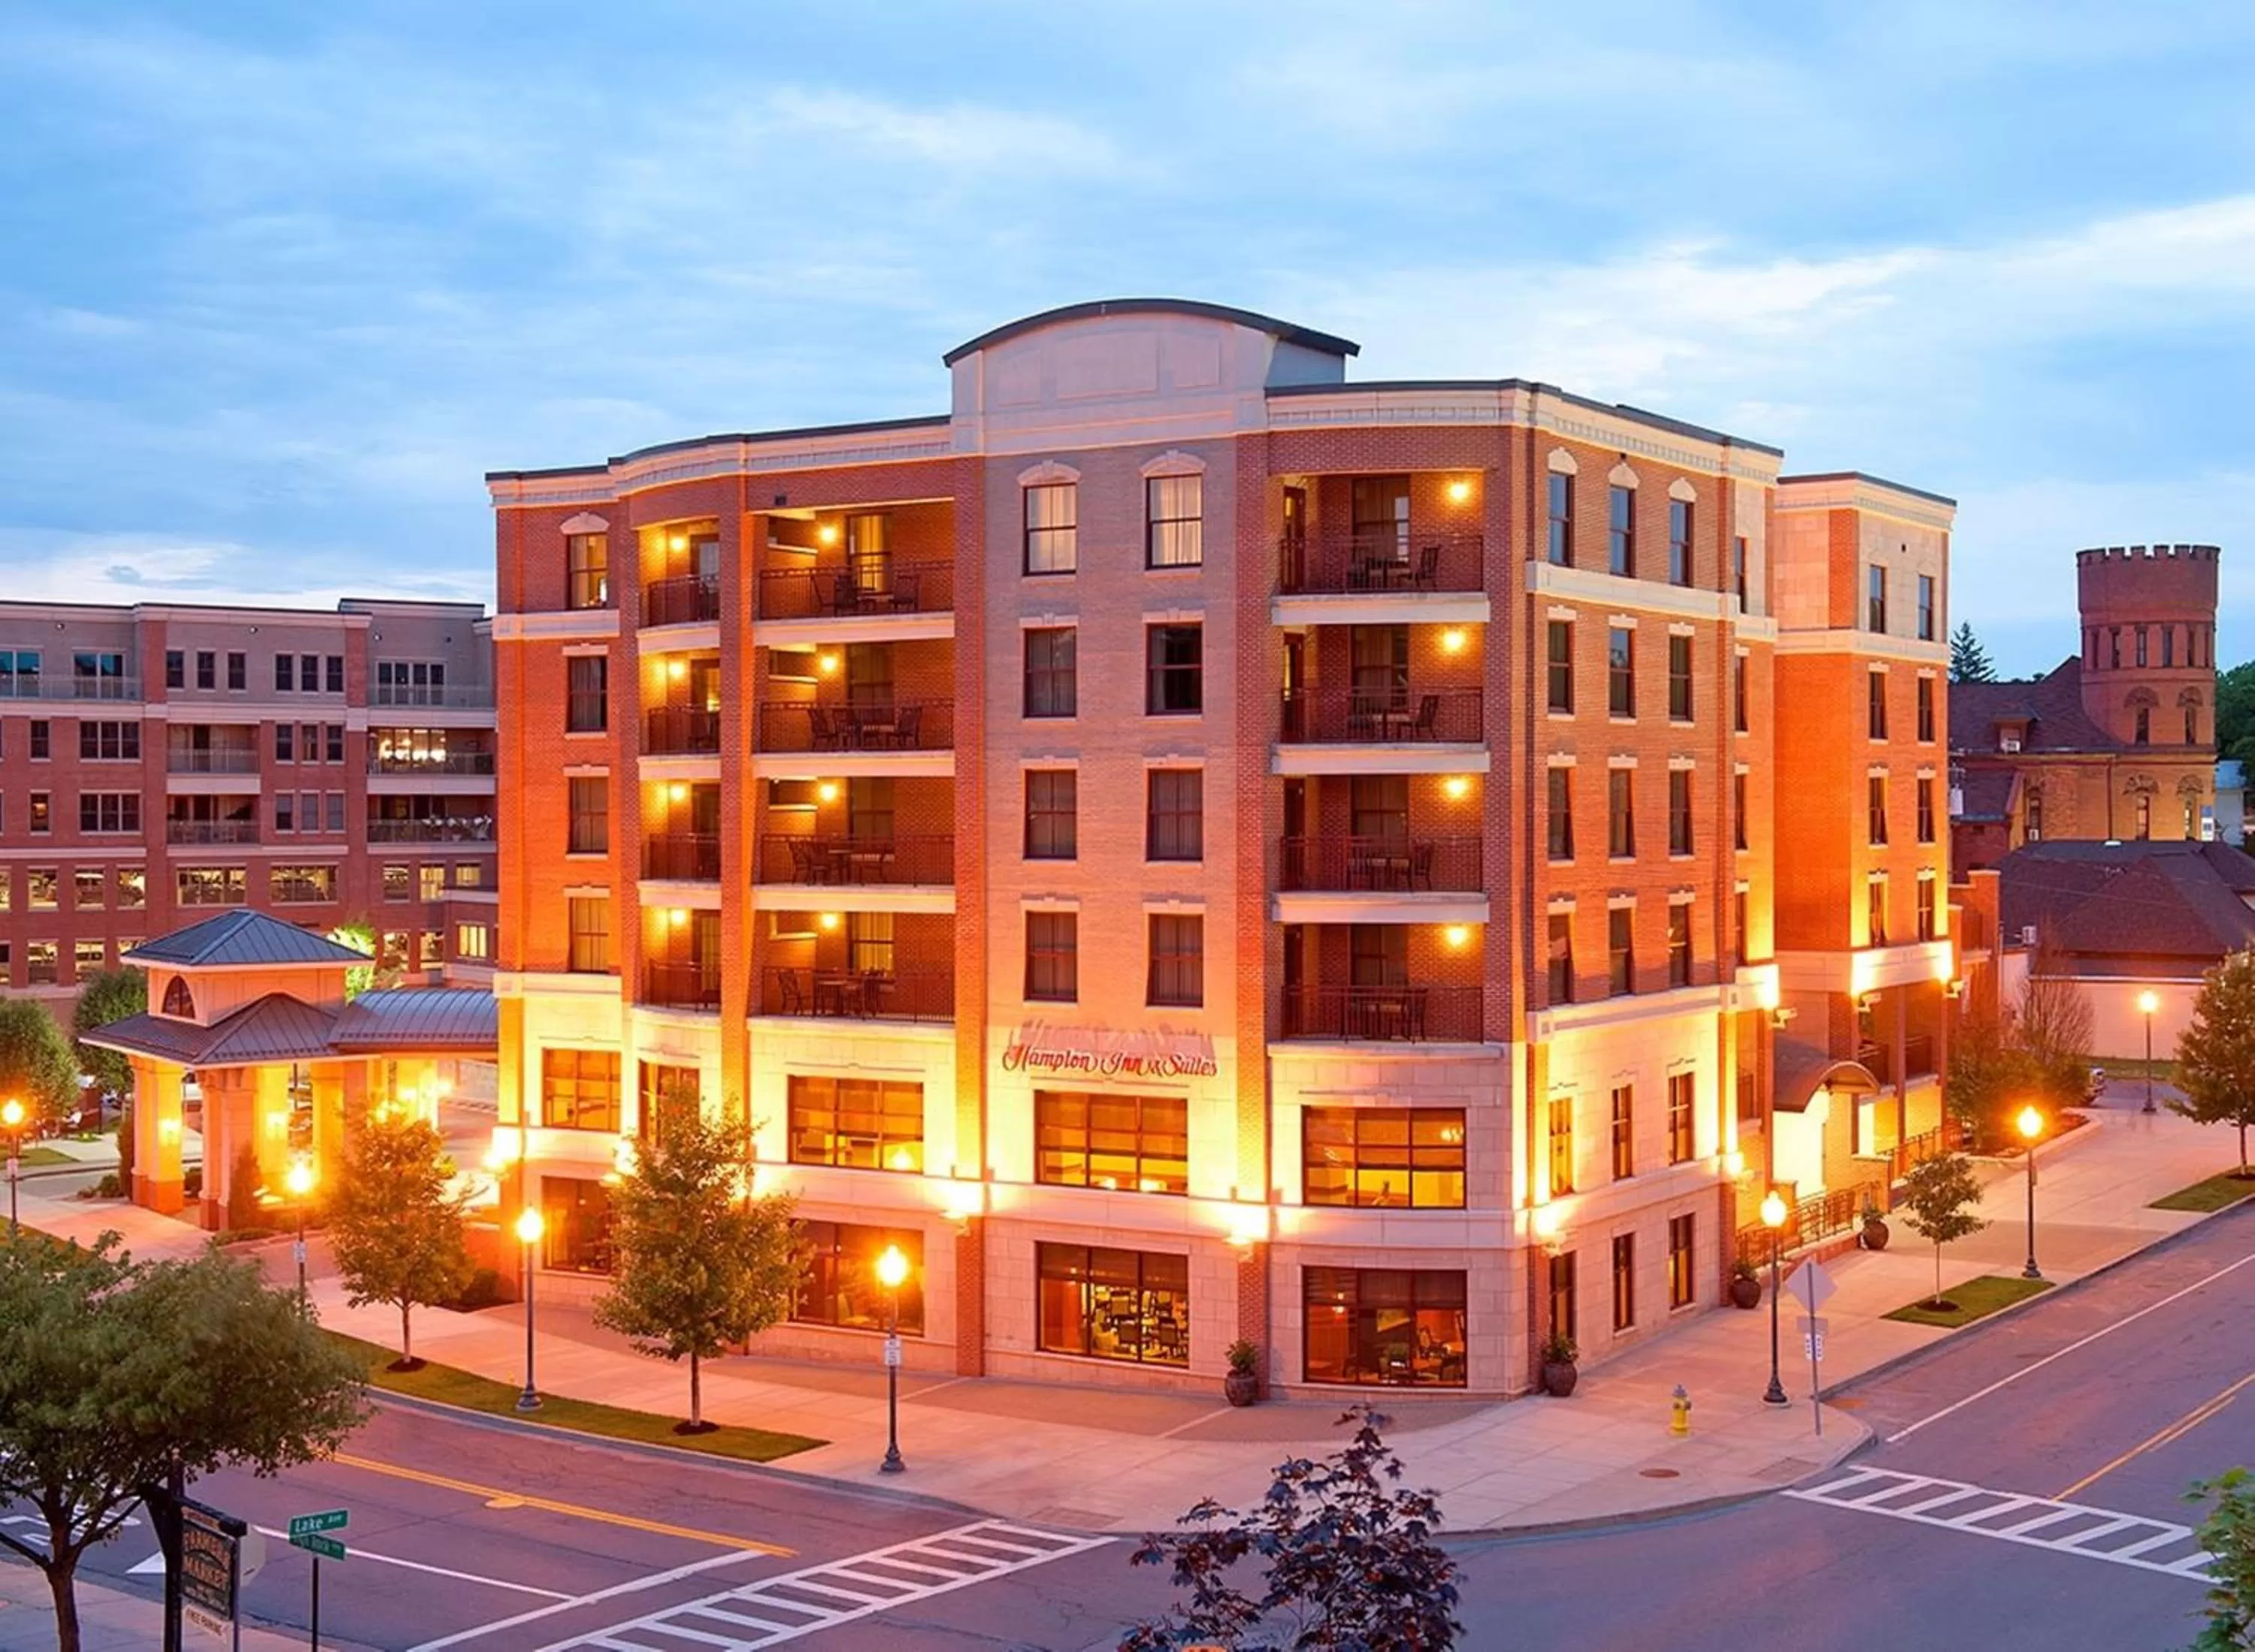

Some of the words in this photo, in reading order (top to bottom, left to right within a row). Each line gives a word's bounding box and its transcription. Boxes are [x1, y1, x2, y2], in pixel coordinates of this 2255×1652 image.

[1002, 1042, 1098, 1072] Hampton
[1100, 1051, 1148, 1076] Inn
[1164, 1053, 1218, 1076] Suites
[295, 1517, 323, 1532] Lake
